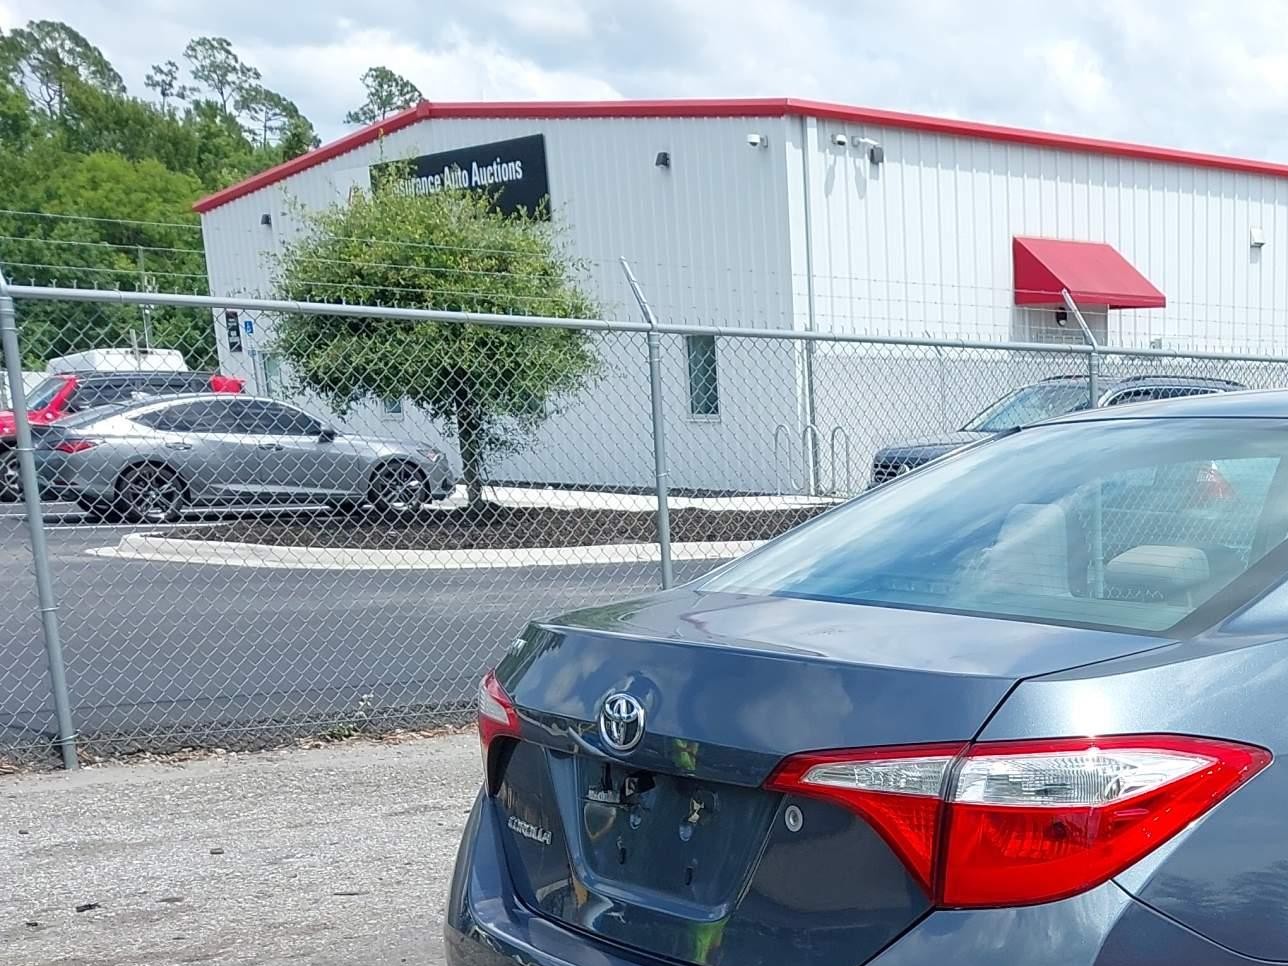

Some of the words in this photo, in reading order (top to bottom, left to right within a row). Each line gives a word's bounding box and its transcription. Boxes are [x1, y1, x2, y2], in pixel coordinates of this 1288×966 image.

[392, 174, 442, 199] surance
[443, 166, 470, 192] Auto
[471, 157, 523, 188] Auctions
[507, 815, 552, 845] COROLLA
